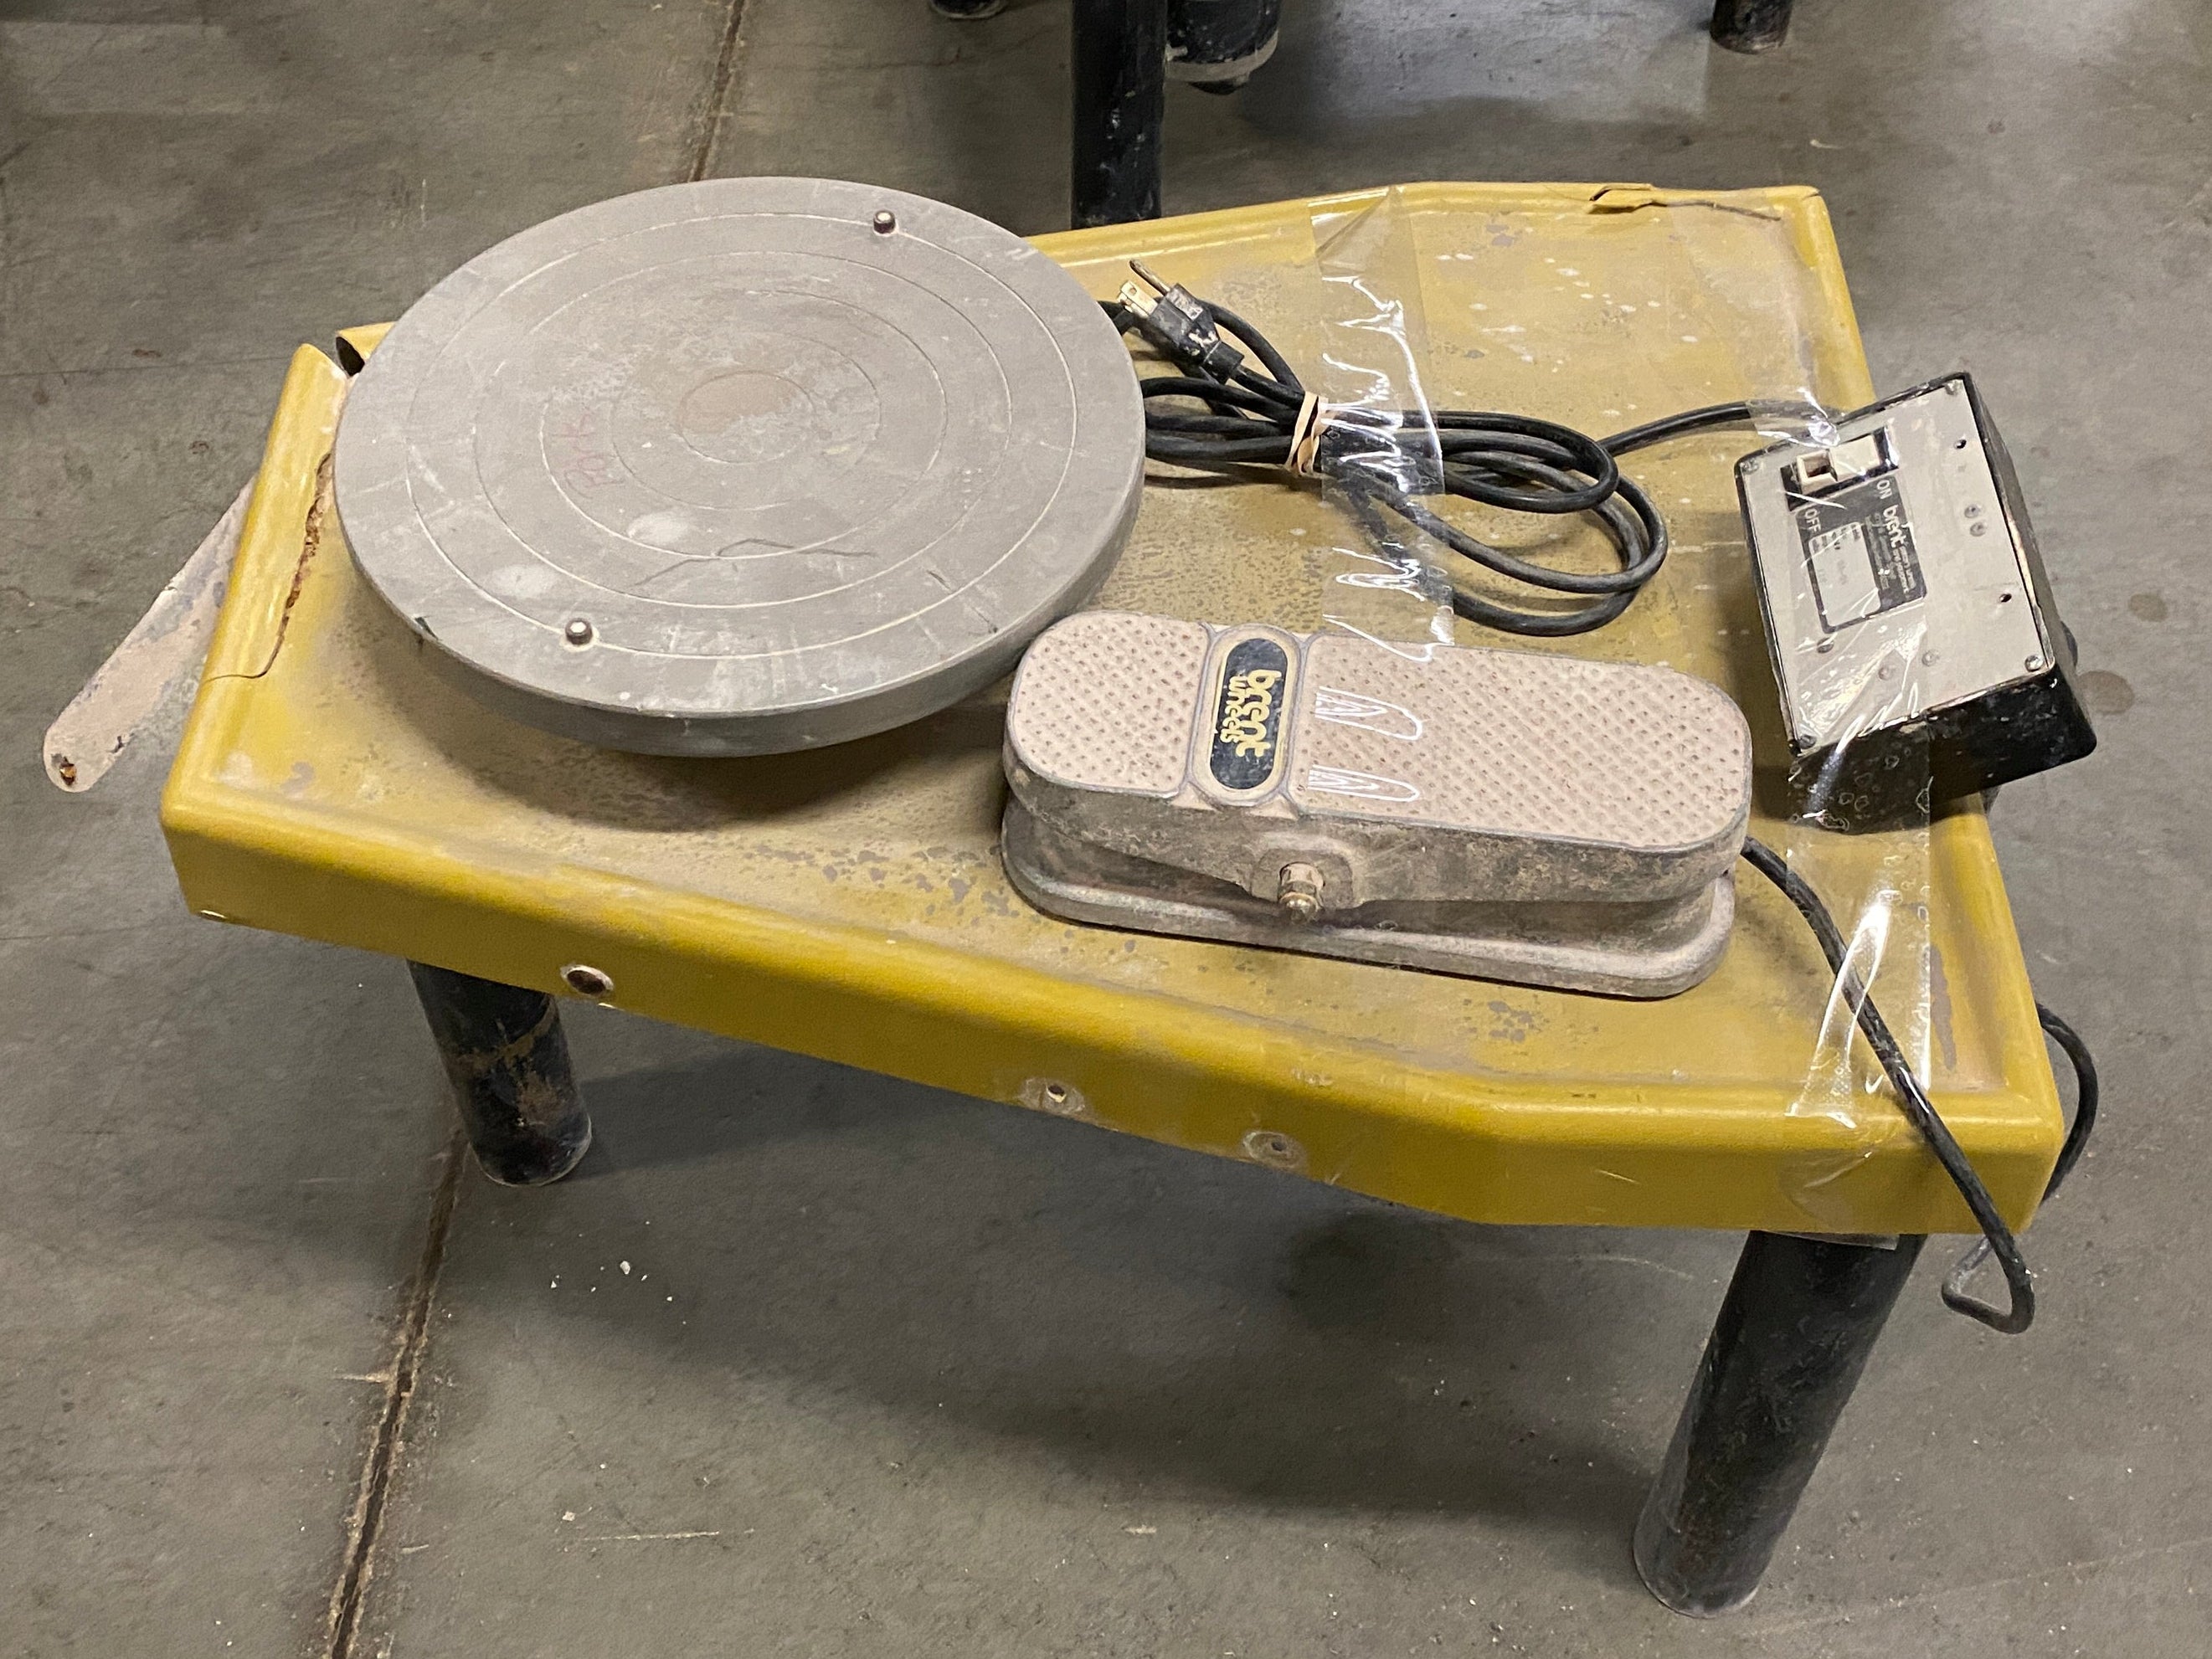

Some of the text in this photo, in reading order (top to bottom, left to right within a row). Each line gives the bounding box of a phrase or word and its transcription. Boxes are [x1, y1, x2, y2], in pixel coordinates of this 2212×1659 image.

[1876, 480, 1892, 500] ON
[1803, 508, 1822, 534] OFF
[1883, 504, 1907, 548] brent
[1219, 675, 1249, 743] wheels
[1235, 669, 1283, 758] brent
